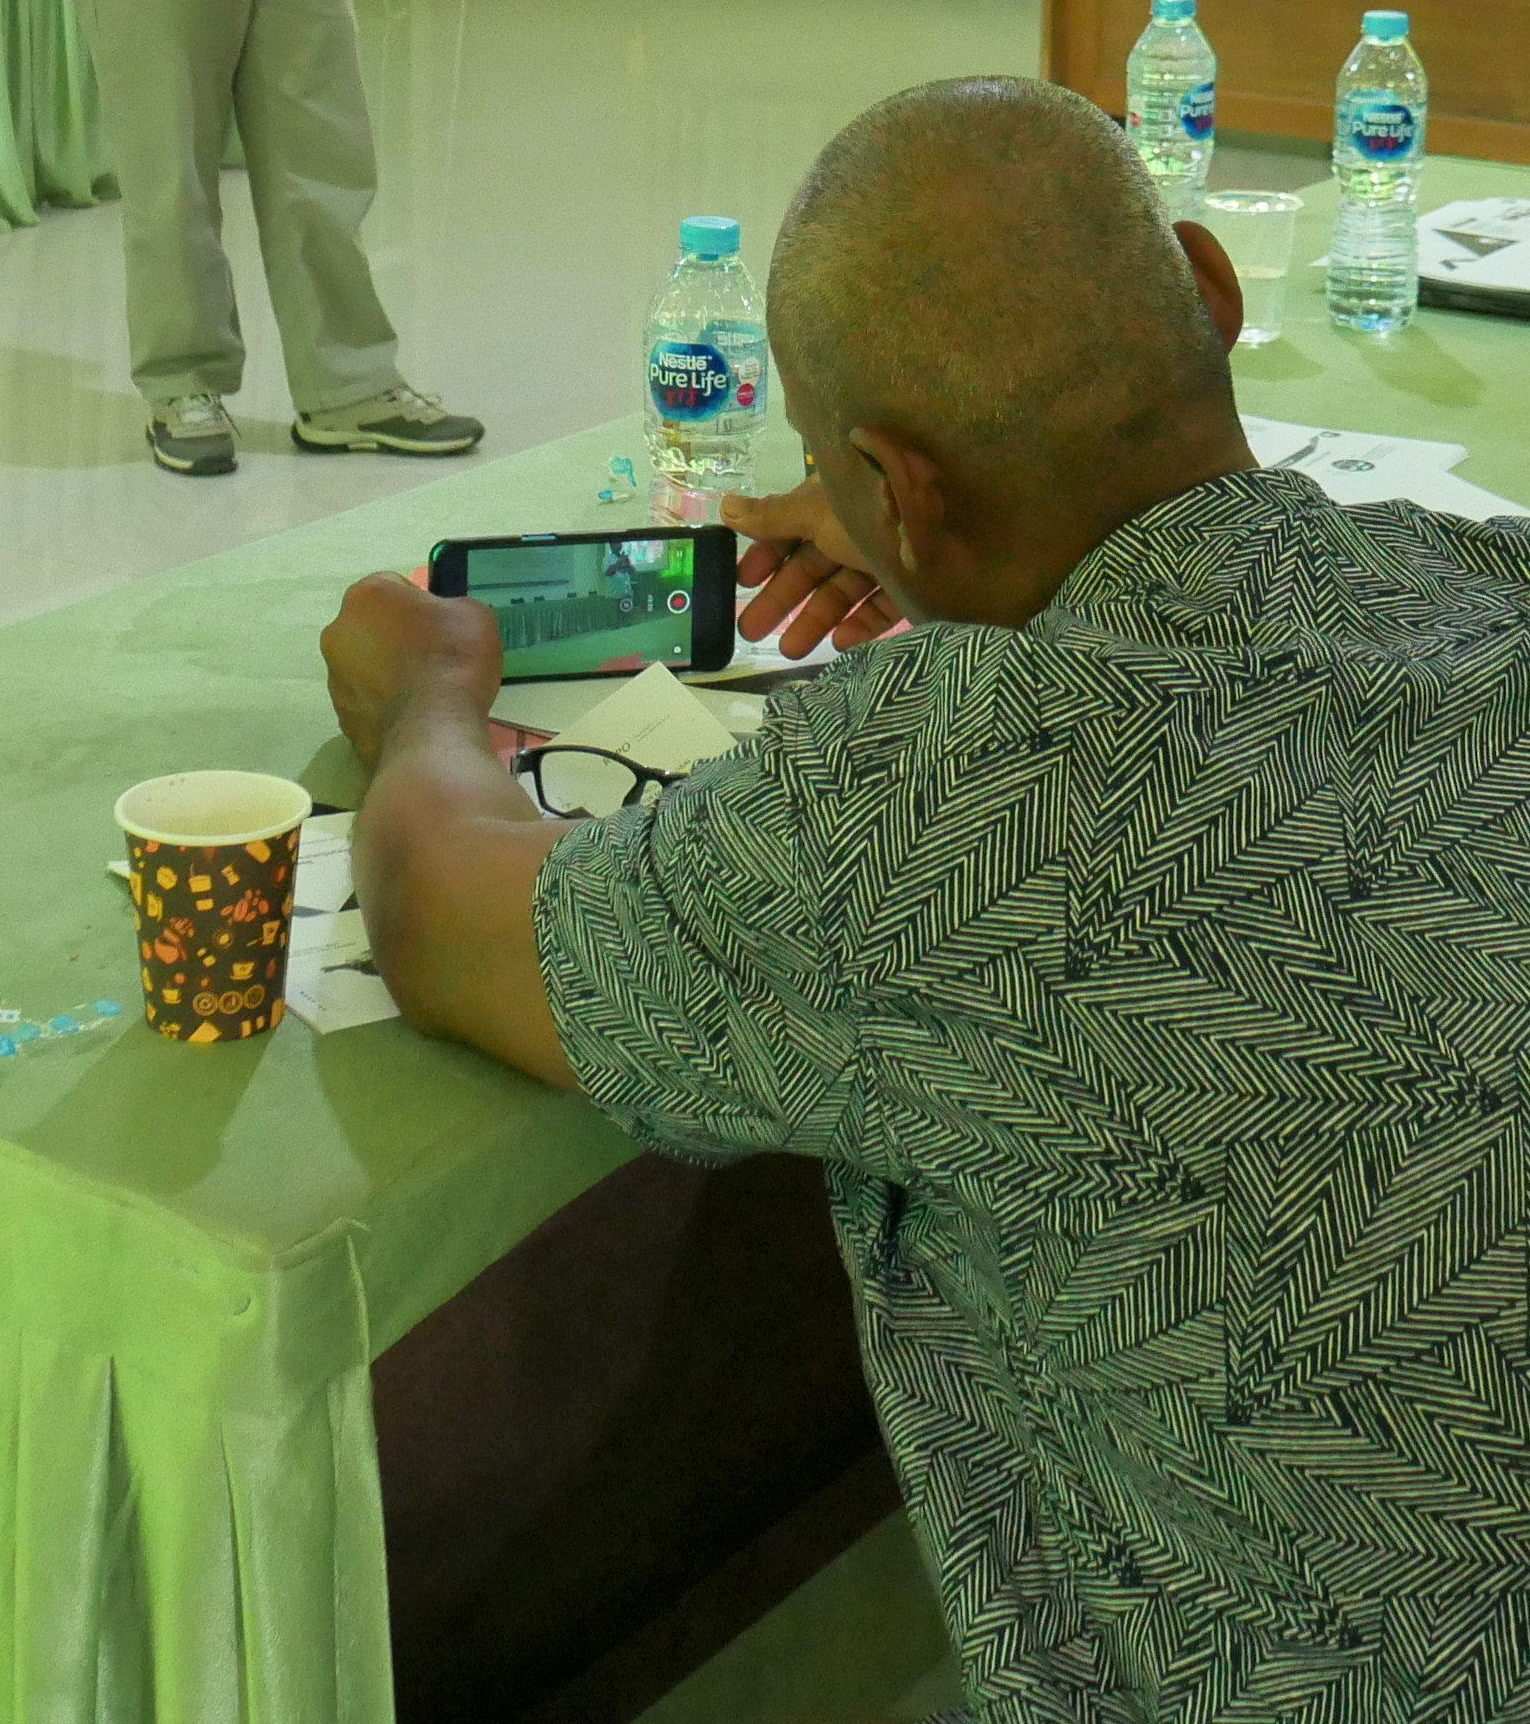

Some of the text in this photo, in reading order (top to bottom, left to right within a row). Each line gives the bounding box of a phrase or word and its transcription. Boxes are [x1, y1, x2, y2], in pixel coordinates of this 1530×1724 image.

[1352, 121, 1388, 138] Pure
[658, 351, 710, 371] Nestlé
[650, 363, 688, 388] Pure
[691, 370, 726, 397] Life
